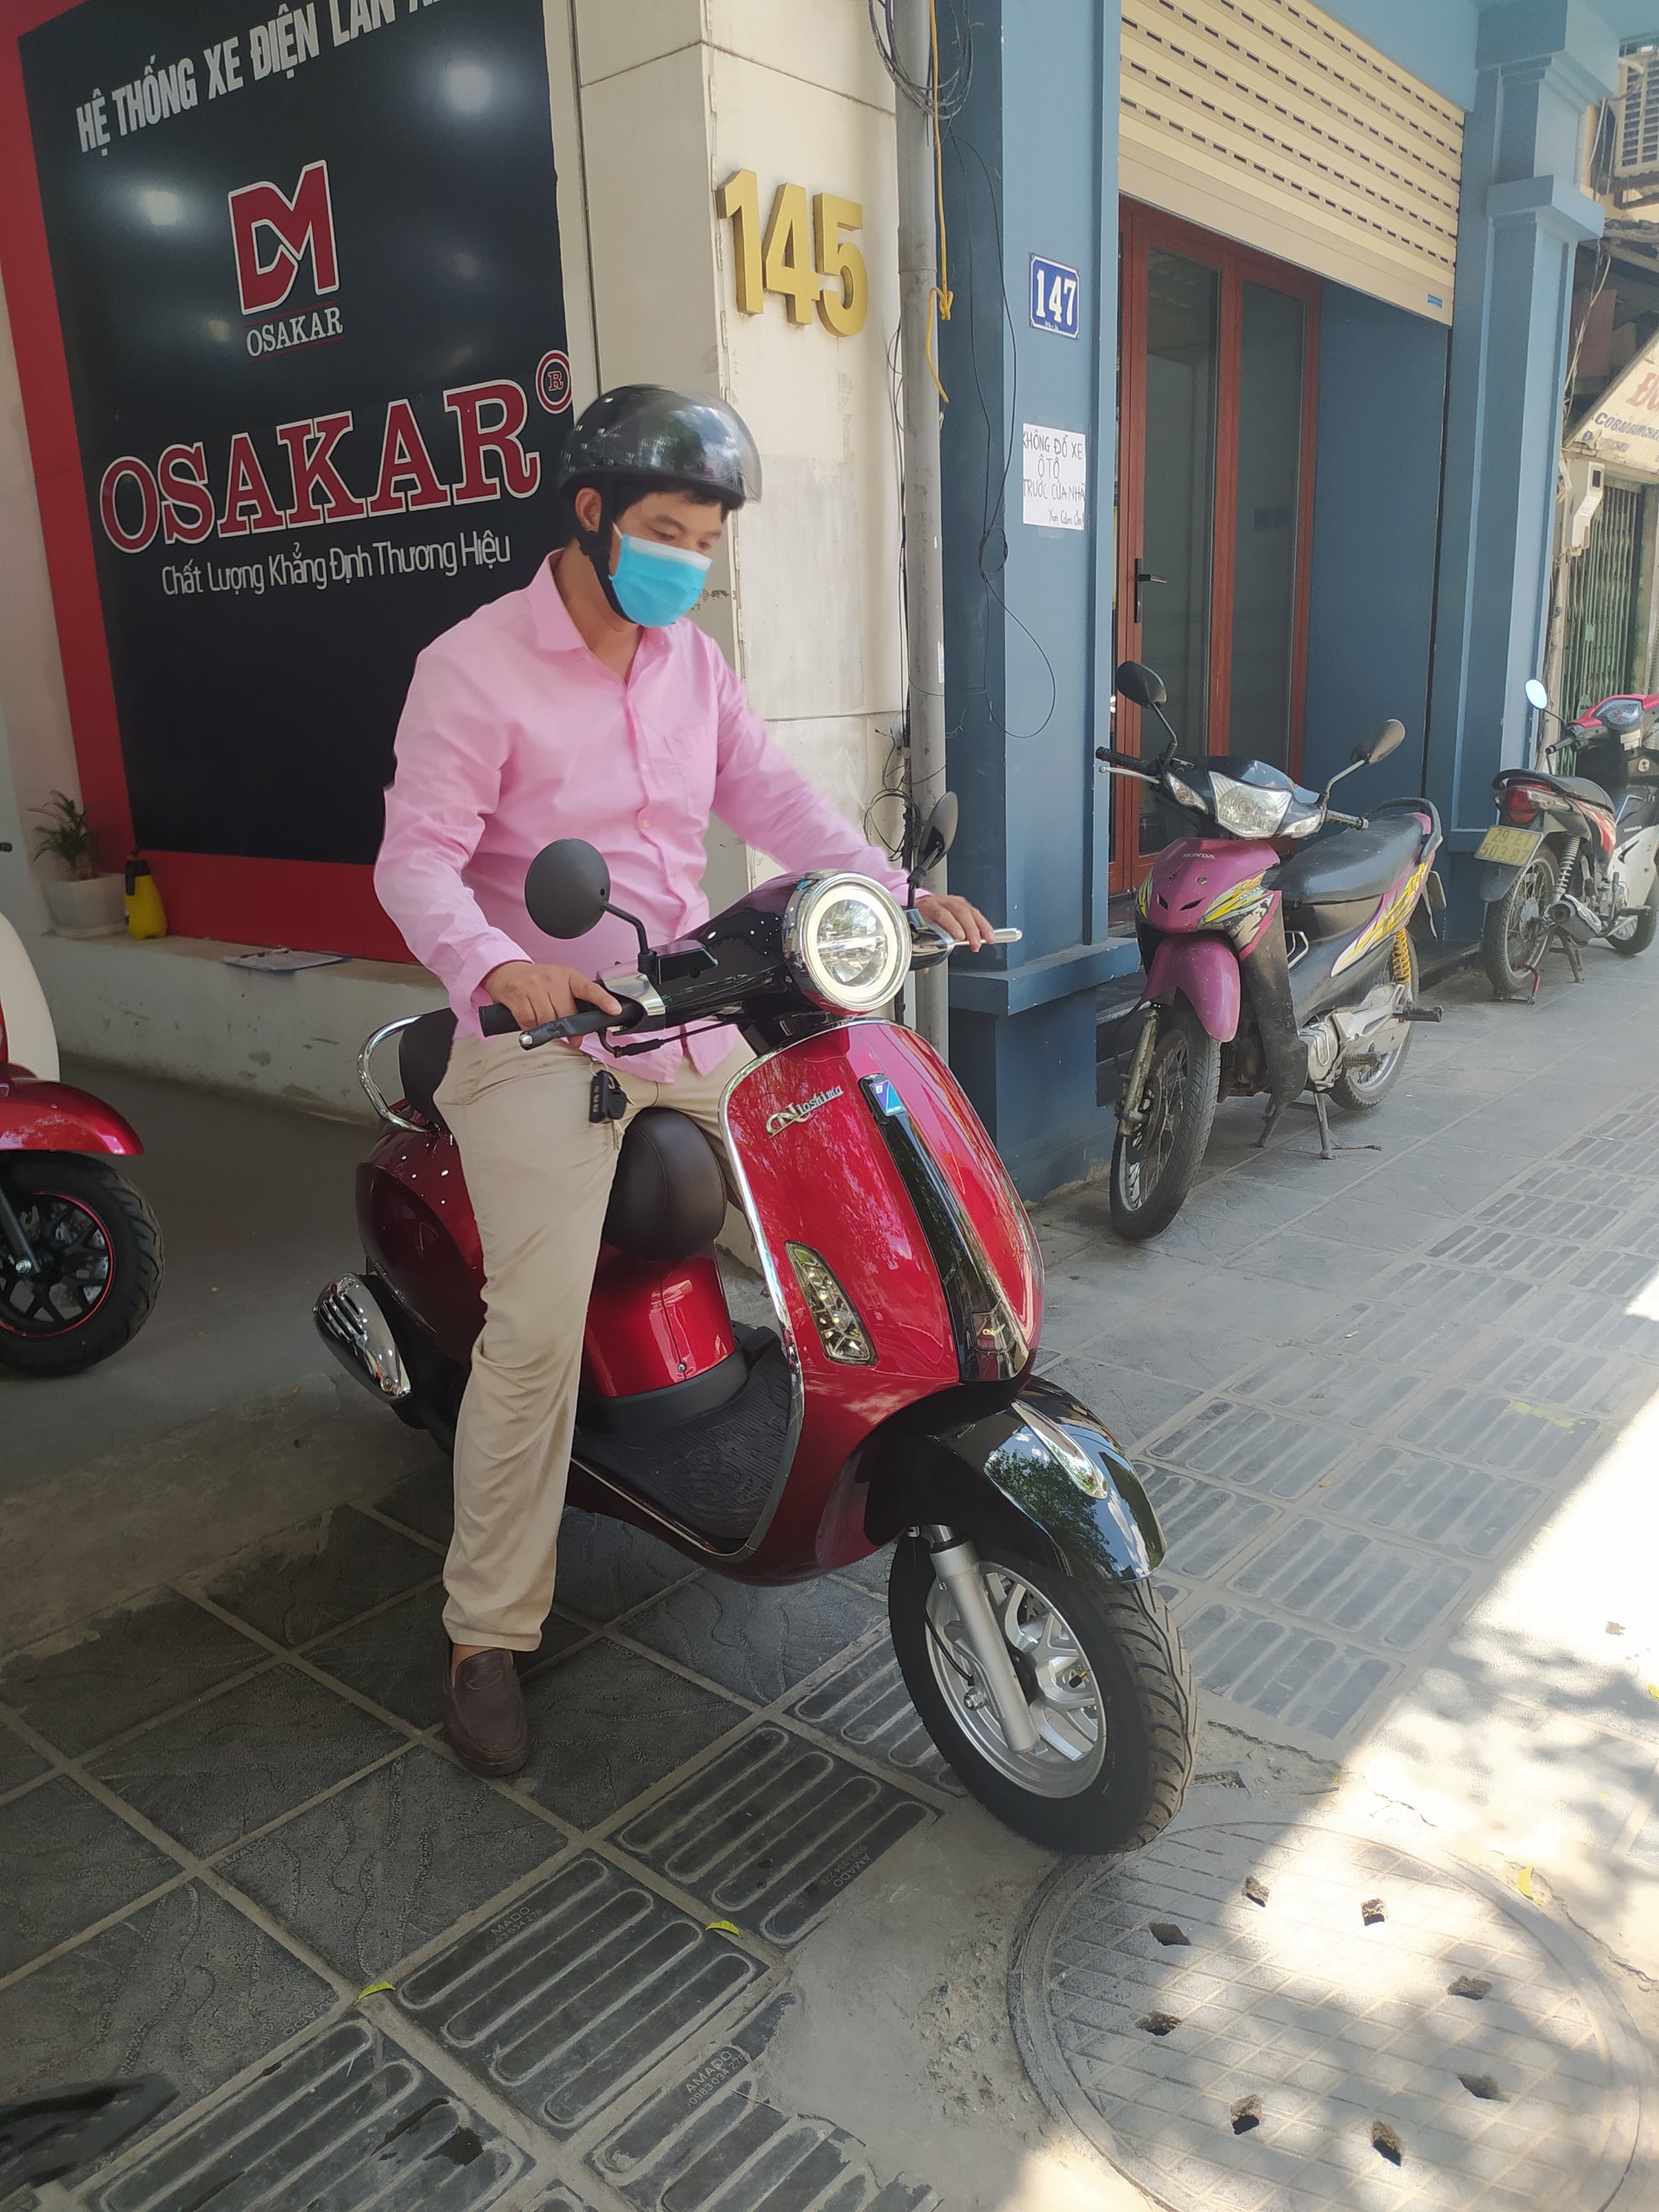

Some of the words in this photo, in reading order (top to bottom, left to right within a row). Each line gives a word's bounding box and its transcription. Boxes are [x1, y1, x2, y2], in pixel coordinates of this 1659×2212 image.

[76, 88, 111, 156] HỆ
[111, 54, 198, 137] THỐNG
[203, 36, 244, 100] XE
[249, 3, 321, 80] ĐIỆN
[717, 168, 869, 338] 145
[1036, 269, 1077, 326] 147
[246, 307, 343, 357] OSAKAR
[99, 379, 540, 554] OSAKAR
[1071, 442, 1083, 461] XE
[162, 558, 204, 595] Chất
[207, 562, 265, 595] Lượng
[268, 542, 327, 590] Khẳng
[329, 543, 372, 584] Định
[372, 540, 458, 577] Thương
[460, 530, 512, 569] Hiệu
[685, 2050, 733, 2094] AMADO
